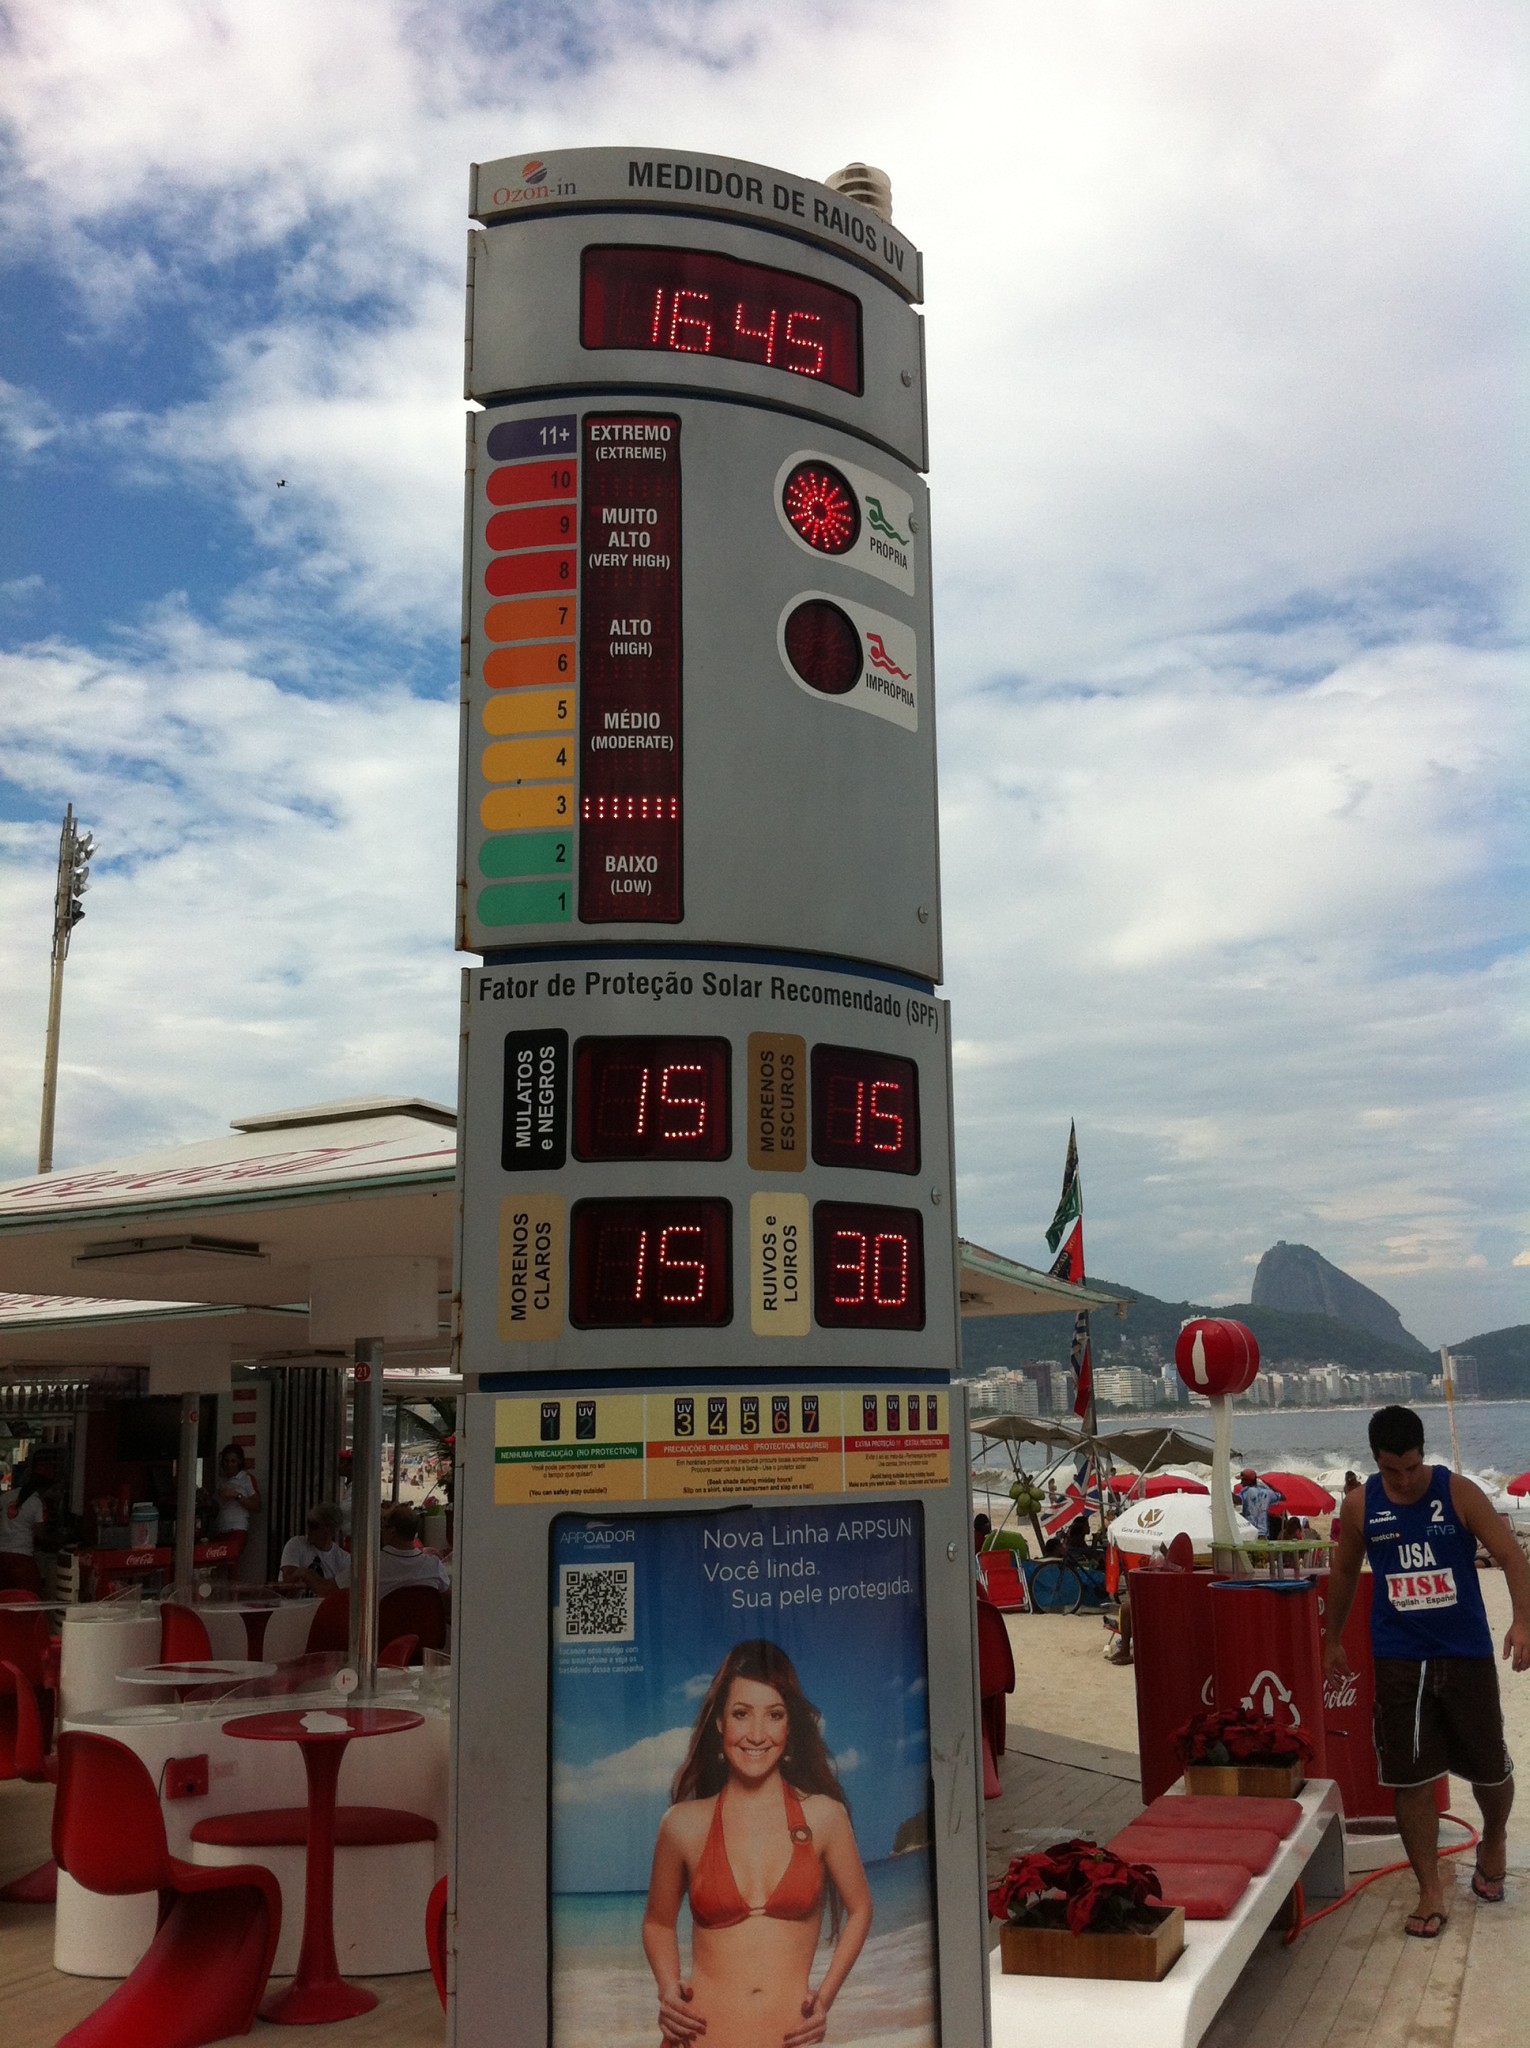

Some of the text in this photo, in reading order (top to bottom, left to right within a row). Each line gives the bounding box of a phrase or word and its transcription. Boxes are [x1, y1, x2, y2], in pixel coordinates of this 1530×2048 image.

[493, 178, 577, 206] Ozon-in
[628, 161, 905, 273] MEDIDOR DE RAIOS UV
[652, 287, 824, 375] 16 45
[539, 425, 570, 446] 11+
[591, 425, 671, 441] EXTREMO
[595, 447, 667, 462] (EXTREME)
[552, 471, 571, 489] 10
[559, 516, 570, 534] 9
[602, 508, 658, 525] MUITO
[608, 532, 650, 548] ALTO
[589, 553, 670, 570] (VERY HIGH)
[870, 536, 908, 570] PRÓPRIA
[559, 562, 569, 579] 8
[558, 607, 568, 625] 7
[609, 619, 651, 636] ALTO
[609, 642, 653, 658] (HIGH)
[557, 654, 568, 672] 6
[866, 673, 915, 708] IMPRÓPRIA
[557, 700, 567, 719] 5
[604, 709, 661, 730] MÉDIO
[591, 735, 674, 752] (MODERATE)
[556, 748, 567, 766] 4
[556, 795, 567, 815] 3
[556, 843, 566, 863] 2
[605, 855, 658, 873] BAIXO
[610, 879, 652, 896] (LOW)
[558, 893, 566, 911] 1
[479, 970, 940, 1035] Fator de Proteção Solar Recomendado (SPF)
[515, 1049, 533, 1149] MULATOS
[538, 1045, 556, 1151] e NEGROS
[636, 1064, 706, 1140] 15
[760, 1049, 775, 1153] MORENOS
[781, 1053, 795, 1151] ESCUROS
[856, 1080, 903, 1151] 15
[511, 1212, 529, 1321] MORENOS
[534, 1221, 551, 1311] CLAROS
[636, 1226, 706, 1302] 15
[762, 1215, 778, 1312] RUIVOS e
[784, 1224, 797, 1303] LOIROS
[835, 1231, 907, 1305] 30
[356, 1366, 367, 1378] 21
[543, 1409, 558, 1418] UV
[579, 1408, 593, 1417] UV
[677, 1404, 692, 1413] UV
[710, 1404, 725, 1412] UV
[743, 1403, 757, 1411] UV
[774, 1402, 788, 1411] UV
[804, 1402, 816, 1410] UV
[864, 1401, 875, 1410] UV
[888, 1401, 898, 1410] UV
[909, 1401, 918, 1409] UV
[579, 1417, 593, 1438] 2
[677, 1413, 692, 1435] 3
[710, 1413, 725, 1434] 4
[743, 1412, 757, 1433] 5
[774, 1411, 788, 1432] 6
[804, 1411, 816, 1431] 7
[865, 1410, 876, 1431] 8
[576, 1447, 590, 1457] (NO
[591, 1446, 638, 1457] PROTECTION)
[1430, 1499, 1445, 1522] 2
[560, 1529, 635, 1544] ARPOADOR
[703, 1517, 912, 1550] Nova Linha ARPSUN
[1398, 1541, 1438, 1570] USA
[703, 1557, 821, 1583] Você linda.
[731, 1576, 914, 1610] Sua pele protegida.
[1389, 1572, 1454, 1598] FISK
[1391, 1598, 1420, 1608] English
[1426, 1593, 1456, 1605] Español
